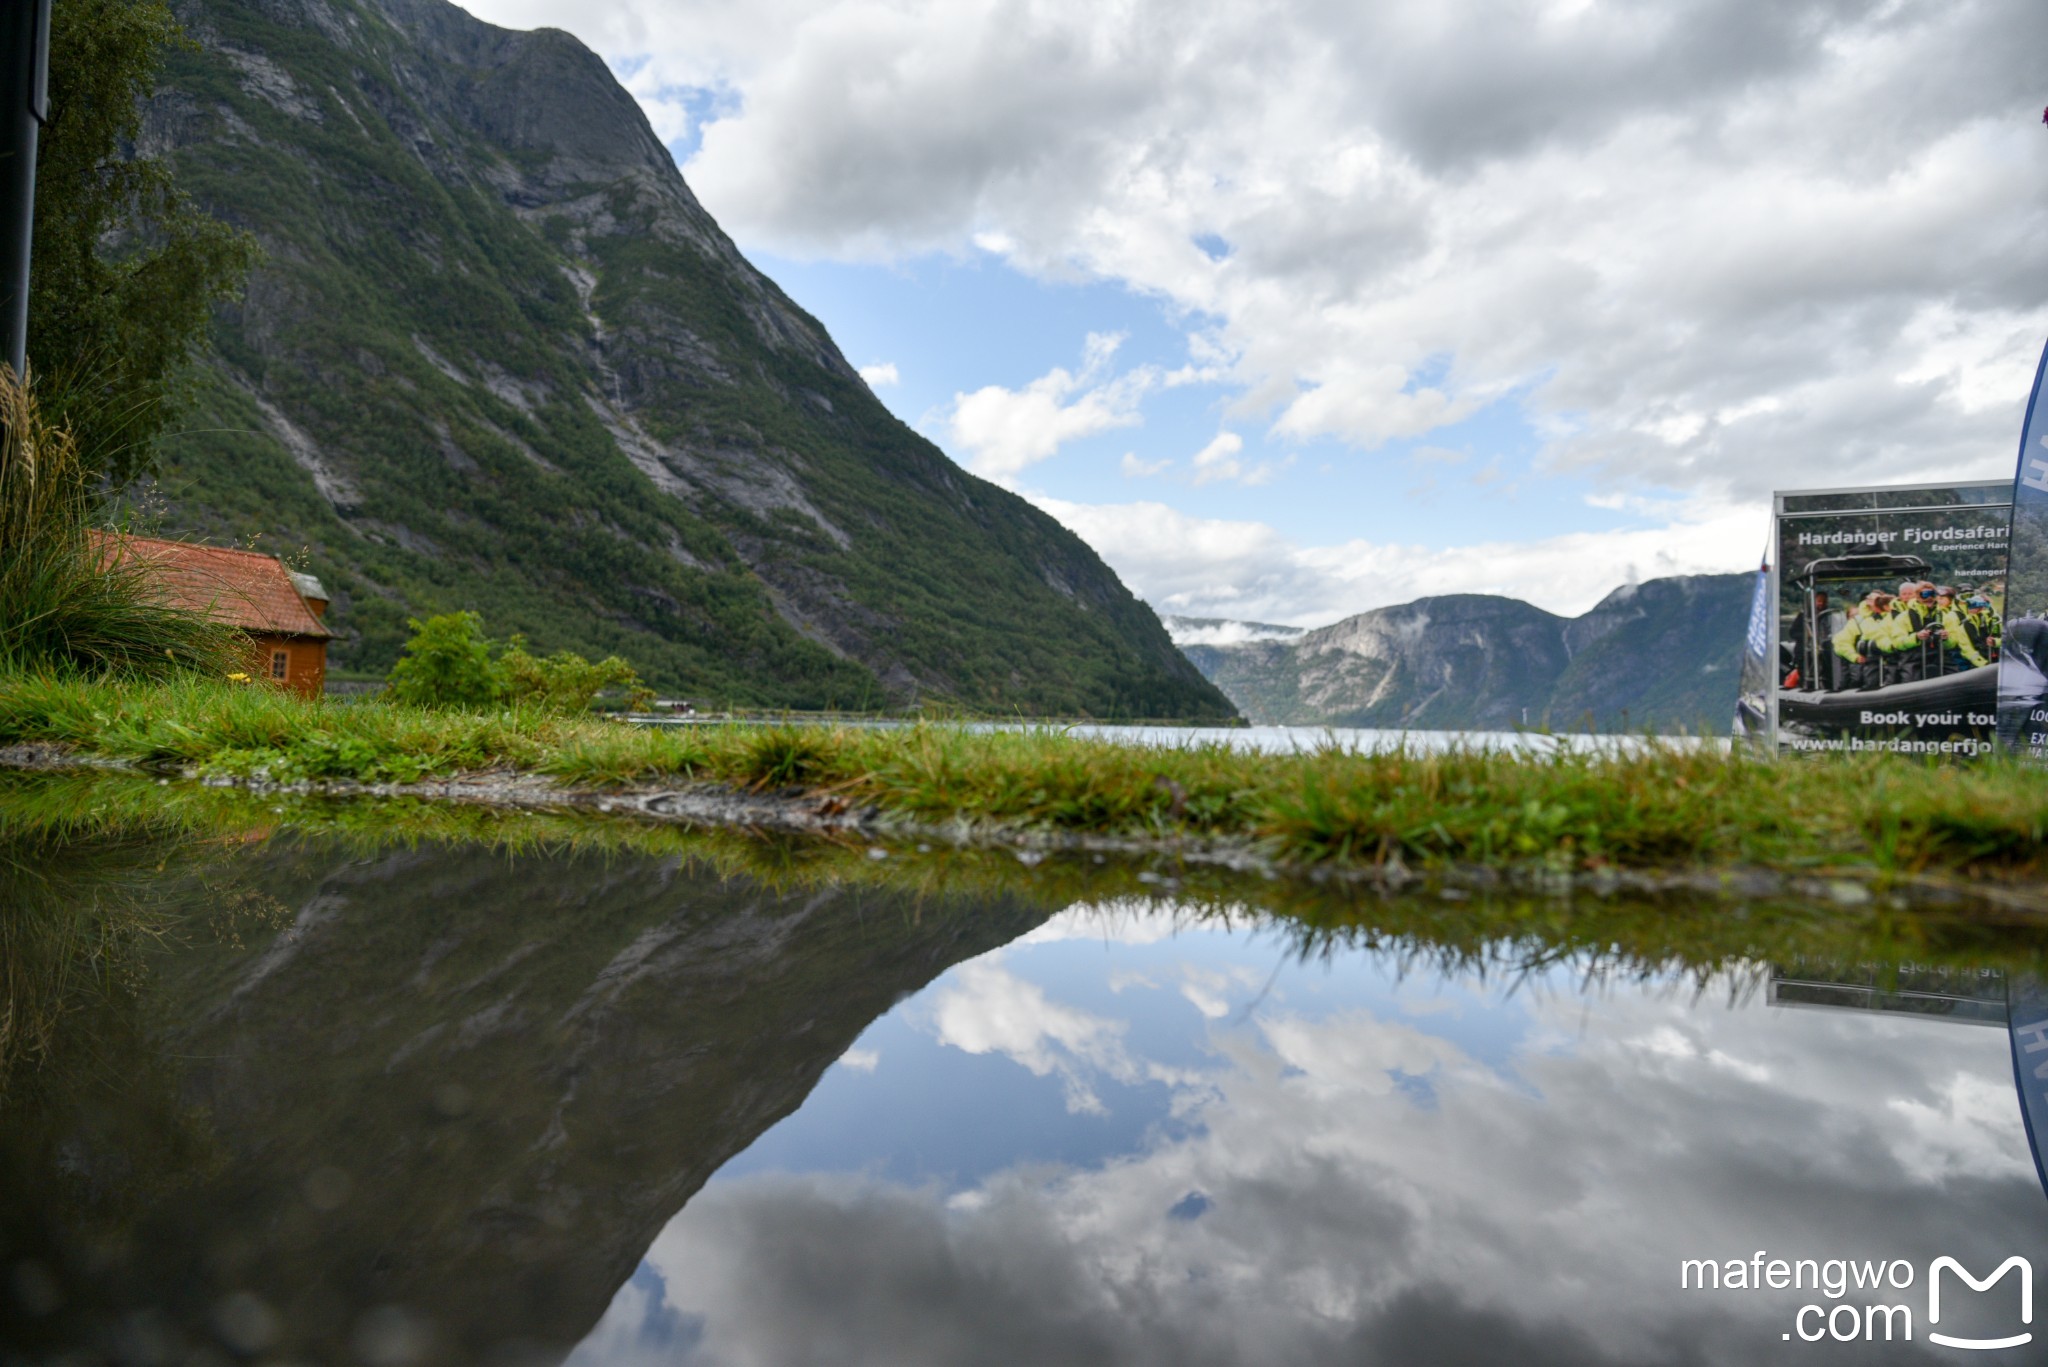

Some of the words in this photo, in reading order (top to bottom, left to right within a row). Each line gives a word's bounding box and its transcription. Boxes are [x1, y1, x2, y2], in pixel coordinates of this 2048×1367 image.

[1798, 528, 1898, 546] Hardanger
[1903, 524, 2010, 544] Fjordsafari
[1931, 543, 1985, 552] Experience
[1860, 711, 1910, 725] Book
[1914, 711, 1962, 728] your
